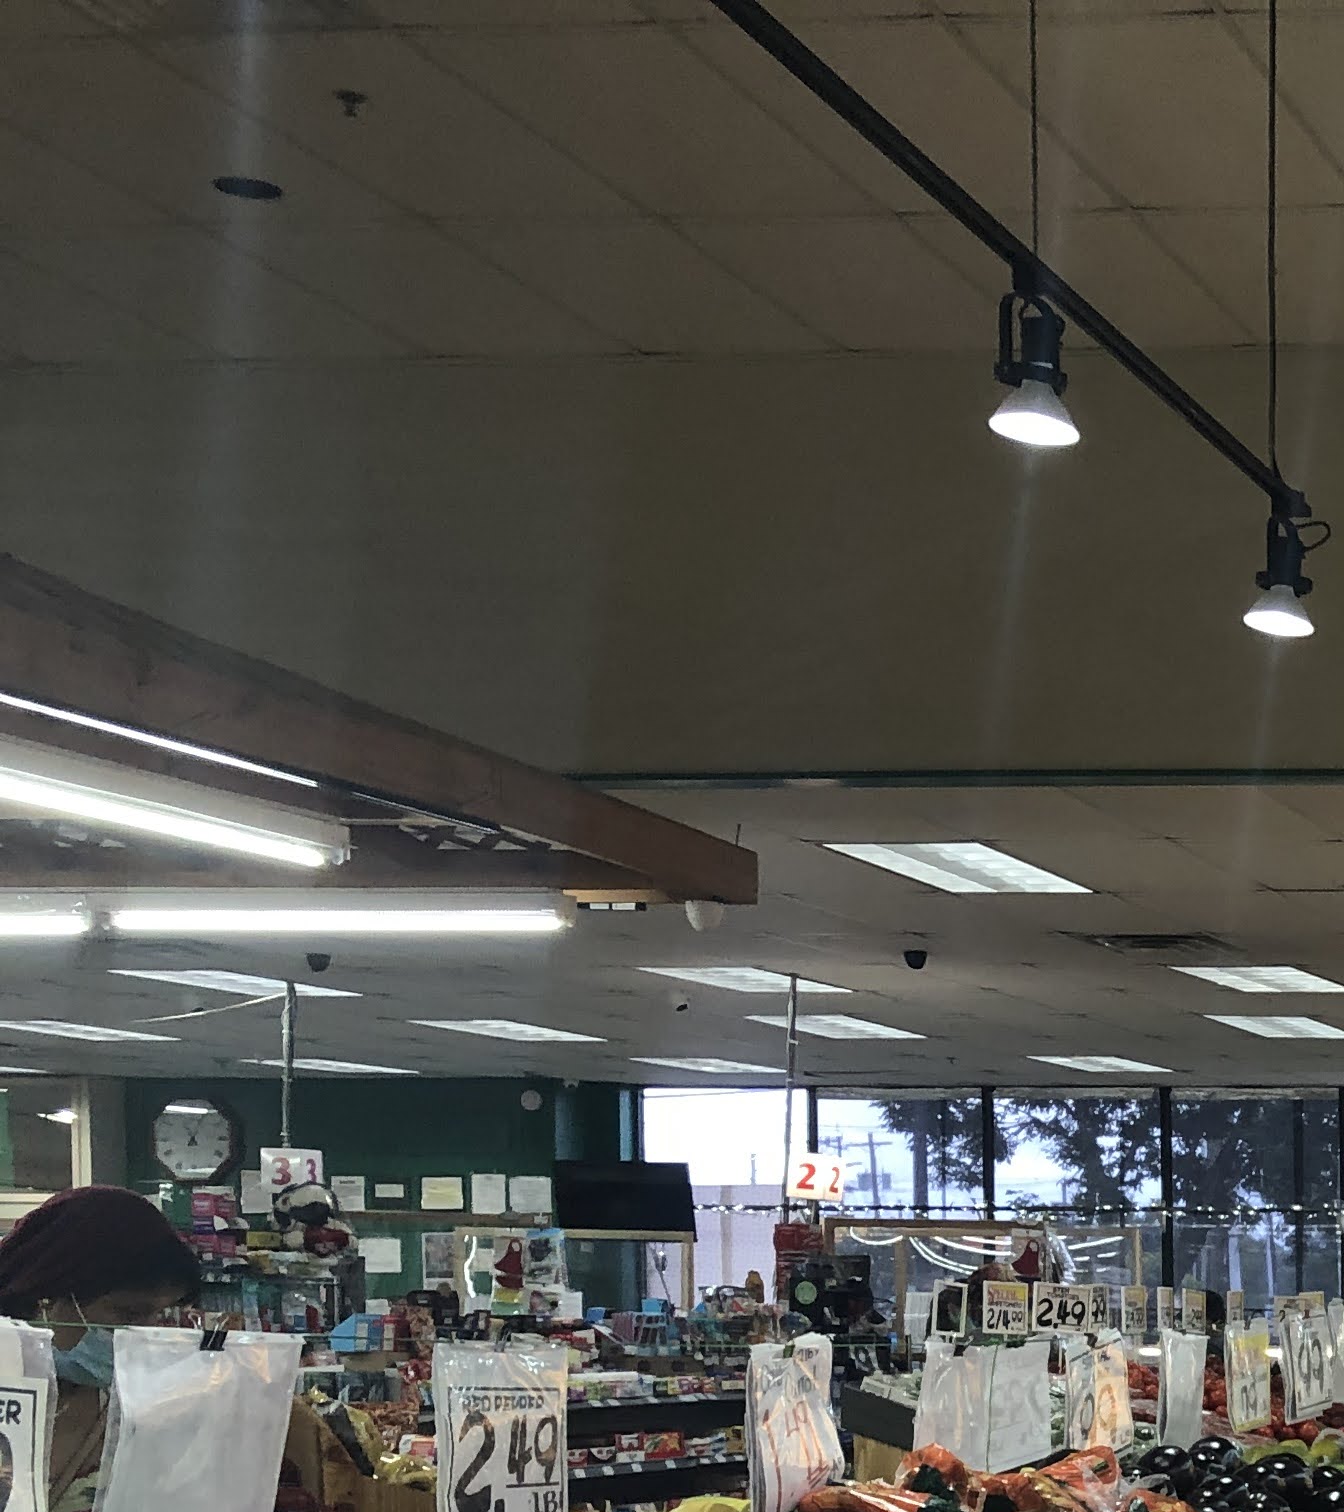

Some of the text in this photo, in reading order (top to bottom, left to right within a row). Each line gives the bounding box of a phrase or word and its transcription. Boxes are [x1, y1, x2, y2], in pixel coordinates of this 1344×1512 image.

[271, 1156, 291, 1186] 3
[796, 1163, 840, 1194] 2 2
[1036, 1298, 1086, 1329] 2.49
